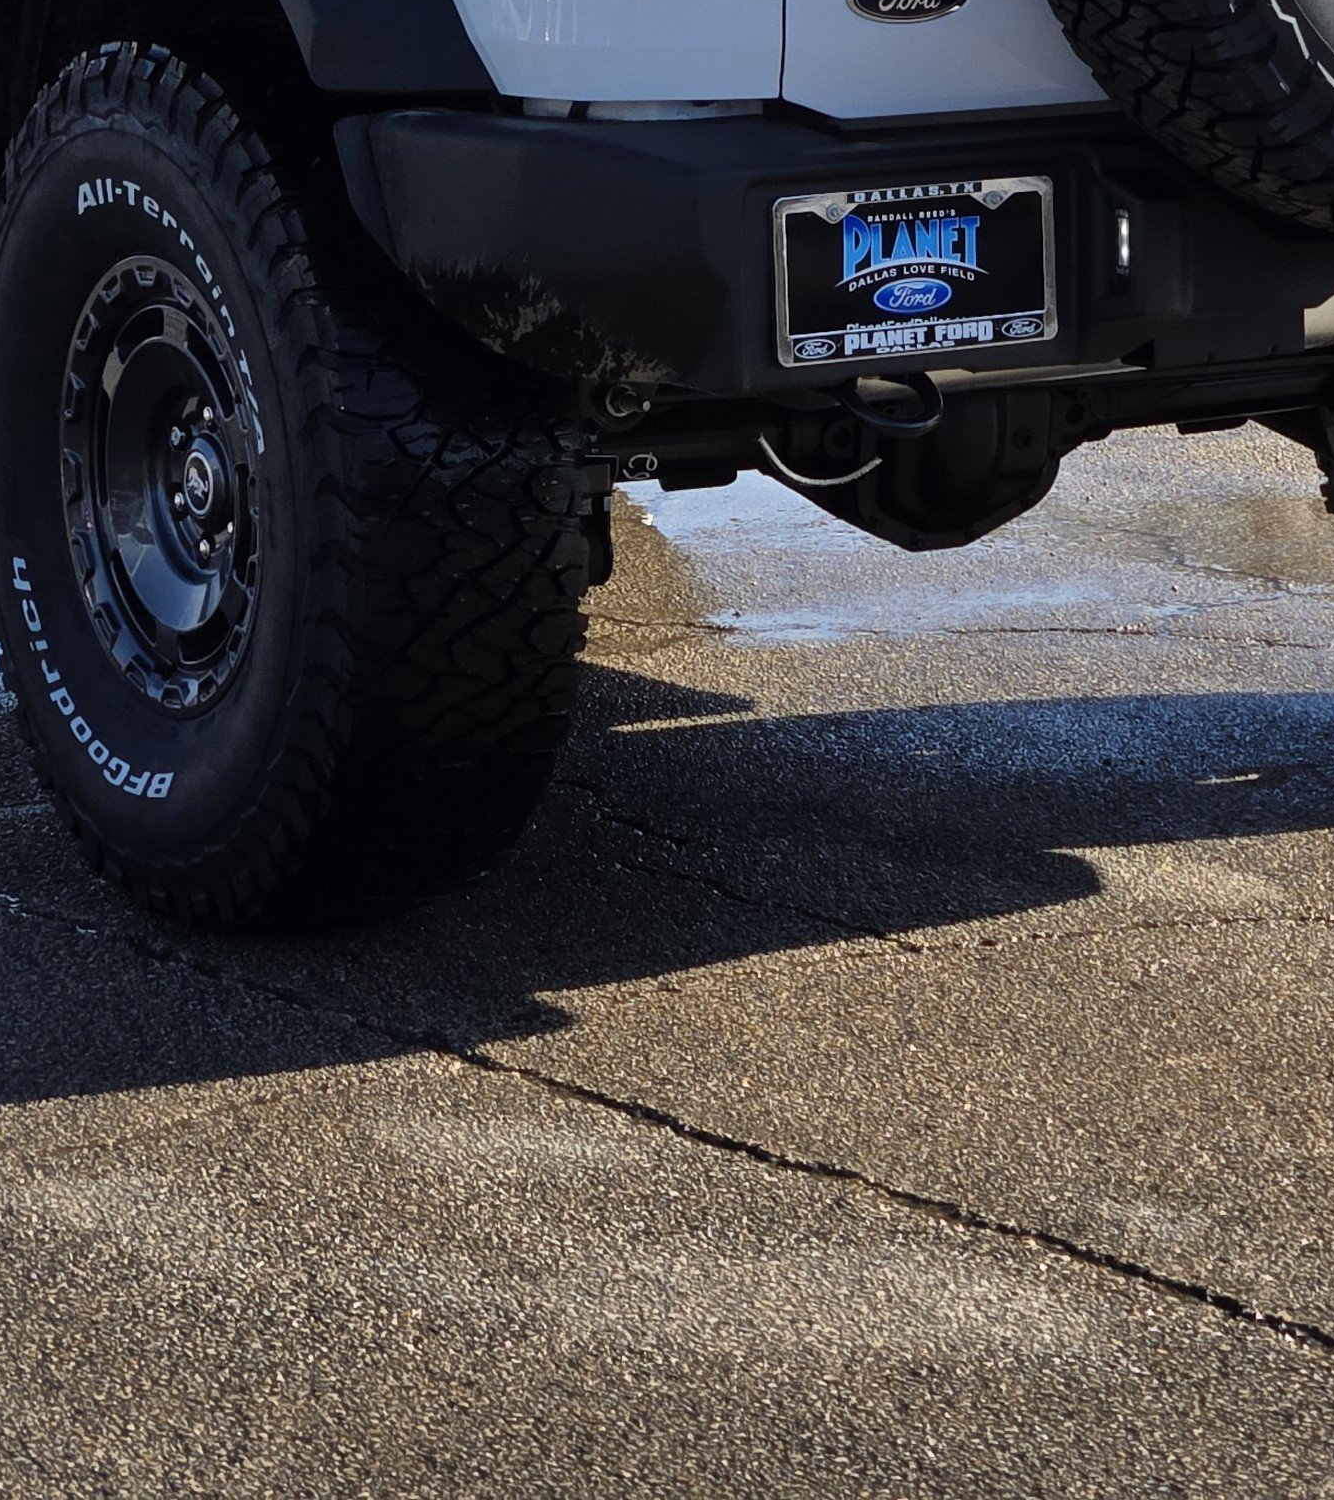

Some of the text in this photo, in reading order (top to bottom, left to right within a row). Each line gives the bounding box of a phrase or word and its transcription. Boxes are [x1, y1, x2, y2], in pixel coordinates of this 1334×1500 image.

[867, 212, 914, 223] RANDALL
[78, 176, 235, 337] All-Terrain
[843, 214, 981, 281] PLANET
[848, 264, 975, 291] DALLAS LOVE FIELD
[889, 283, 937, 308] Ford
[844, 320, 994, 355] PLANET FORD
[13, 556, 174, 798] BFGoodrich
